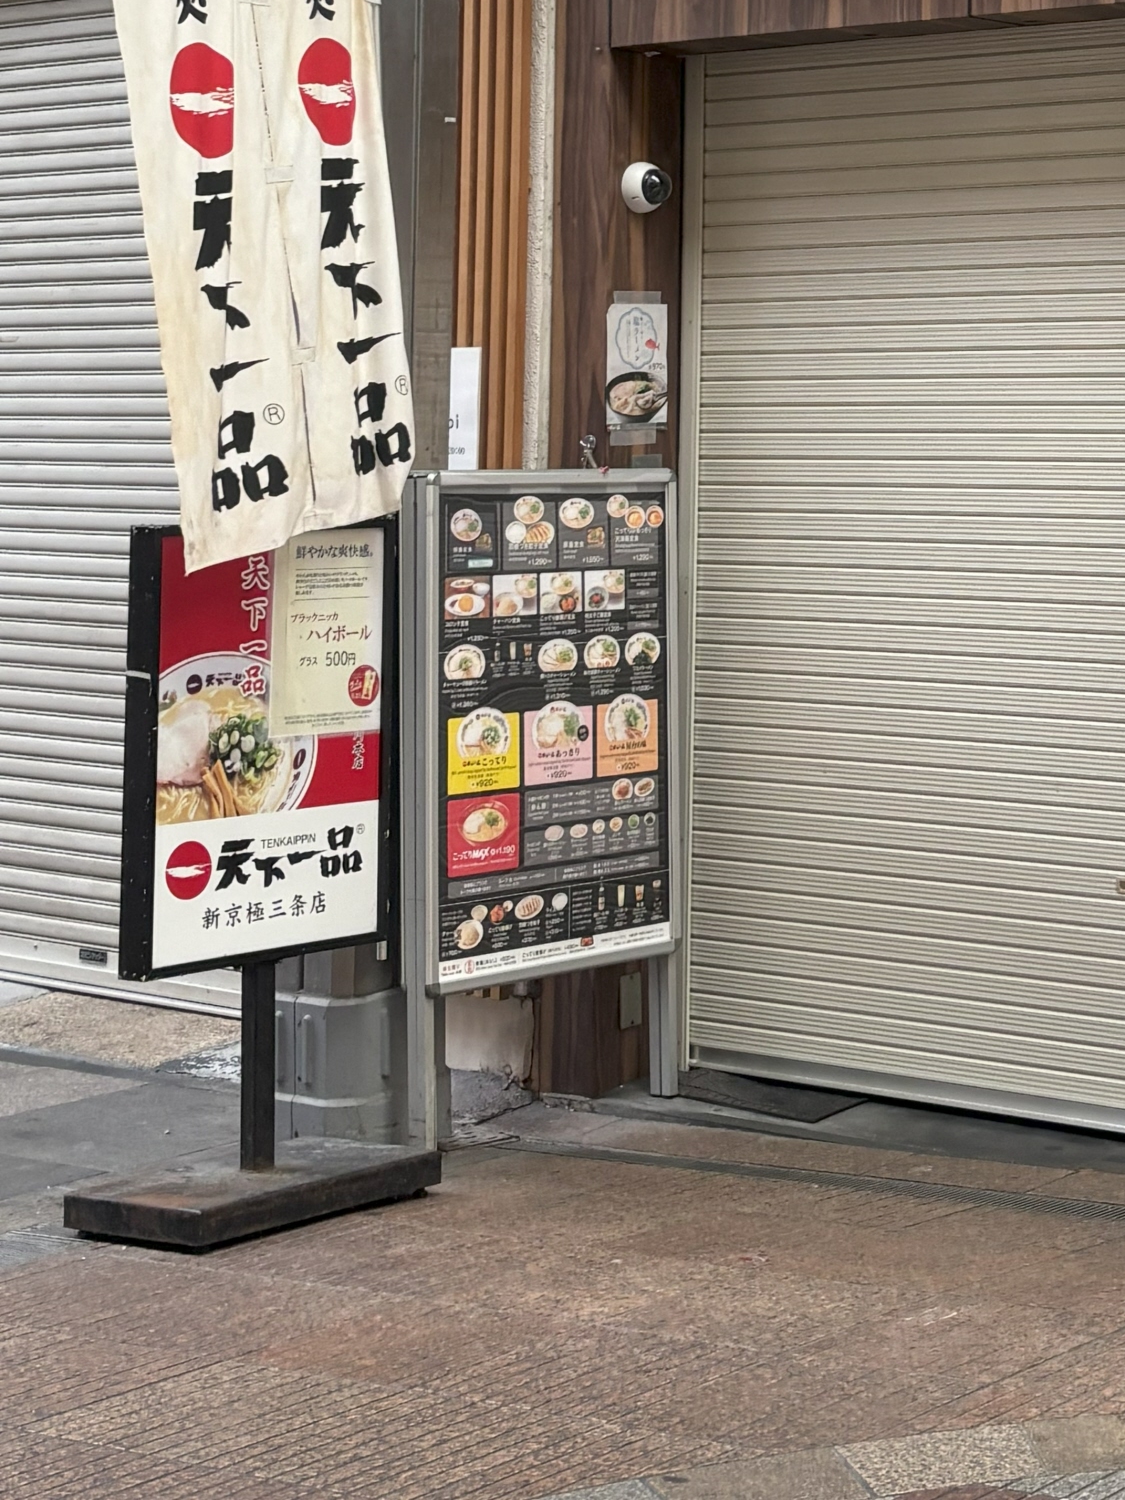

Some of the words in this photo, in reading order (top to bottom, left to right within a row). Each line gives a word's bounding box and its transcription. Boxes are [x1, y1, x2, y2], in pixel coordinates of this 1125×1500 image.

[290, 611, 339, 624] ブラックニッカ
[239, 556, 271, 698] 天下一品
[306, 625, 373, 643] ハイボール
[325, 651, 357, 668] 500円
[260, 833, 316, 850] TENKAIPPIN
[214, 825, 363, 892] 天下一品
[202, 890, 327, 930] 新京極三条店
